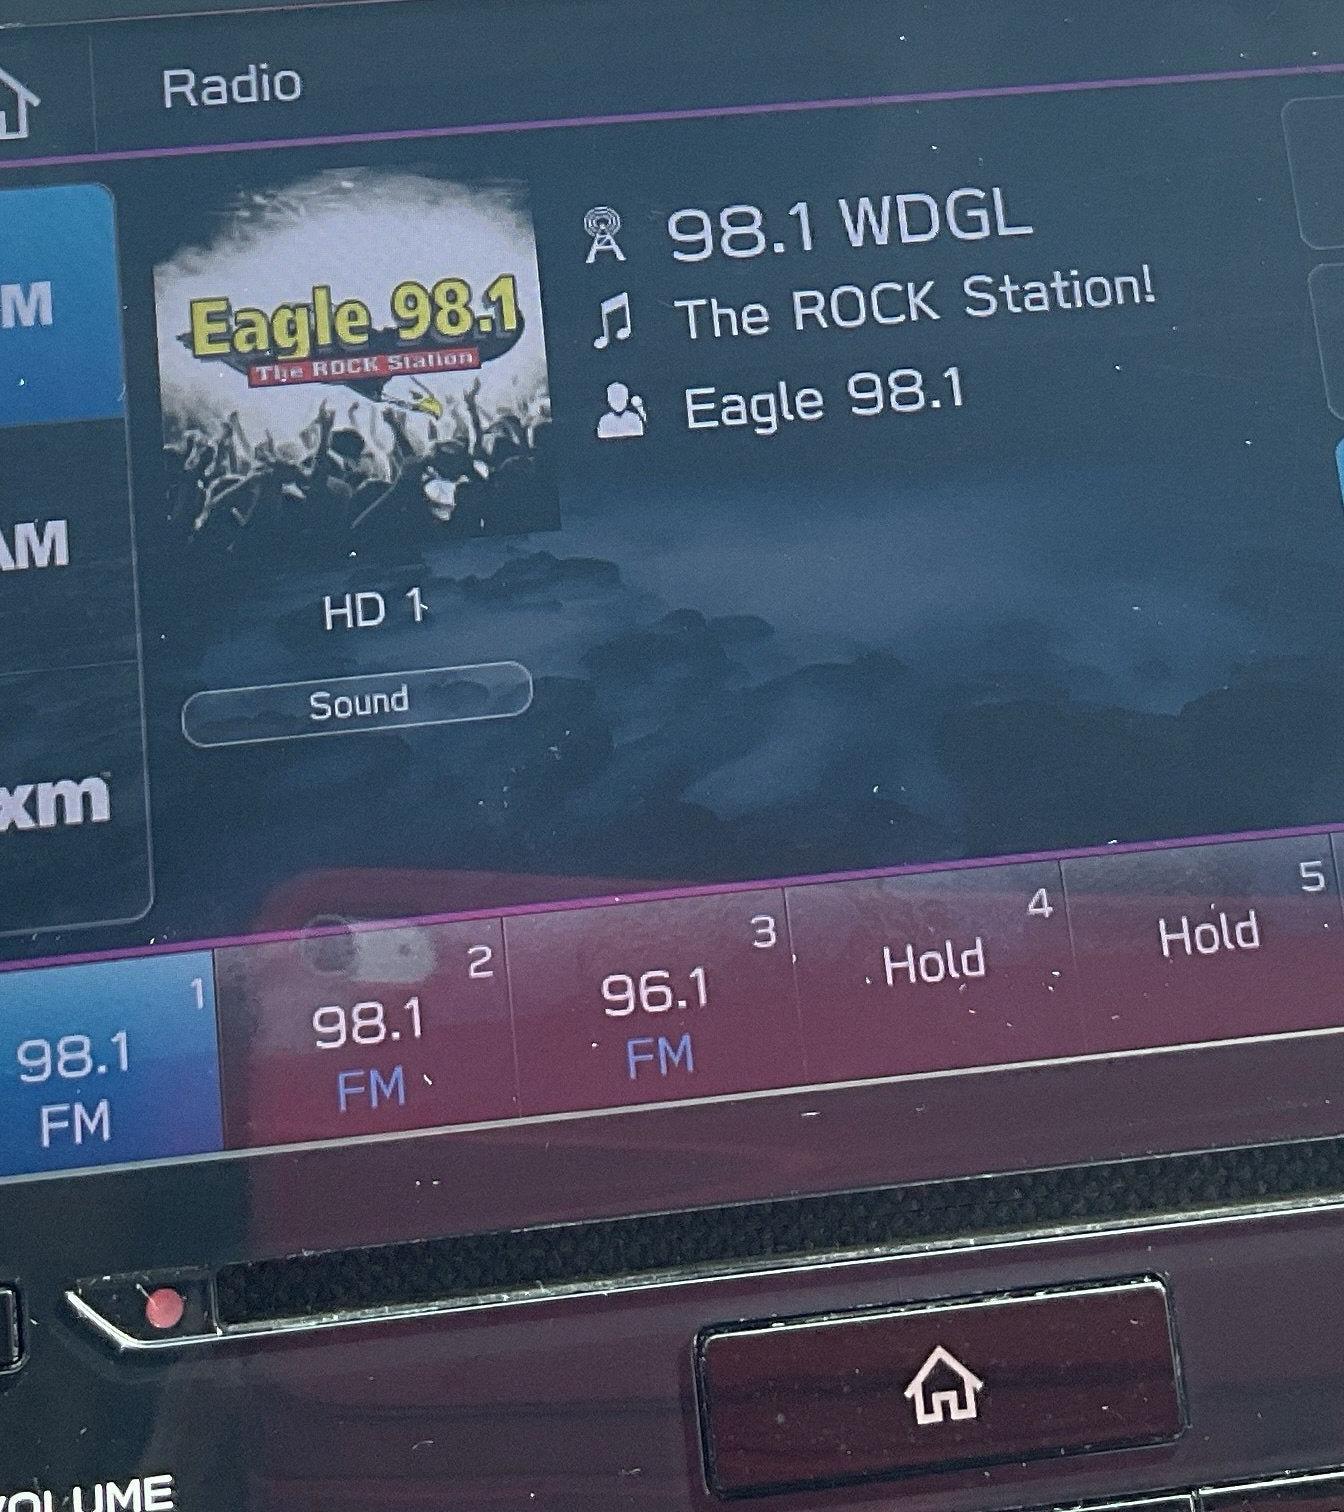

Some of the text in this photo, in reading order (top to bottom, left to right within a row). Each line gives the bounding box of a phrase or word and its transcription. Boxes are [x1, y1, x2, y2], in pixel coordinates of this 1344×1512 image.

[163, 62, 302, 109] Radio
[668, 187, 1034, 262] 98.1 WDGL
[189, 272, 519, 360] Eagle 98.1
[674, 263, 1157, 340] The ROCK Station!
[256, 350, 474, 383] The ROCK Station
[685, 366, 965, 437] Eagle 98.1
[323, 587, 424, 631] HD 1
[309, 684, 410, 722] Sound
[1299, 859, 1326, 892] 5
[1027, 888, 1053, 919] 4
[750, 915, 778, 949] 3
[1159, 909, 1261, 958] Hold
[467, 945, 494, 980] 2
[883, 936, 987, 986] Hold
[190, 976, 206, 1010] 1
[601, 966, 709, 1019] 96.1
[312, 996, 425, 1051] 98.1
[17, 1031, 131, 1085] 98.1
[627, 1032, 695, 1080] FM
[337, 1064, 407, 1113] FM
[39, 1099, 112, 1149] FM
